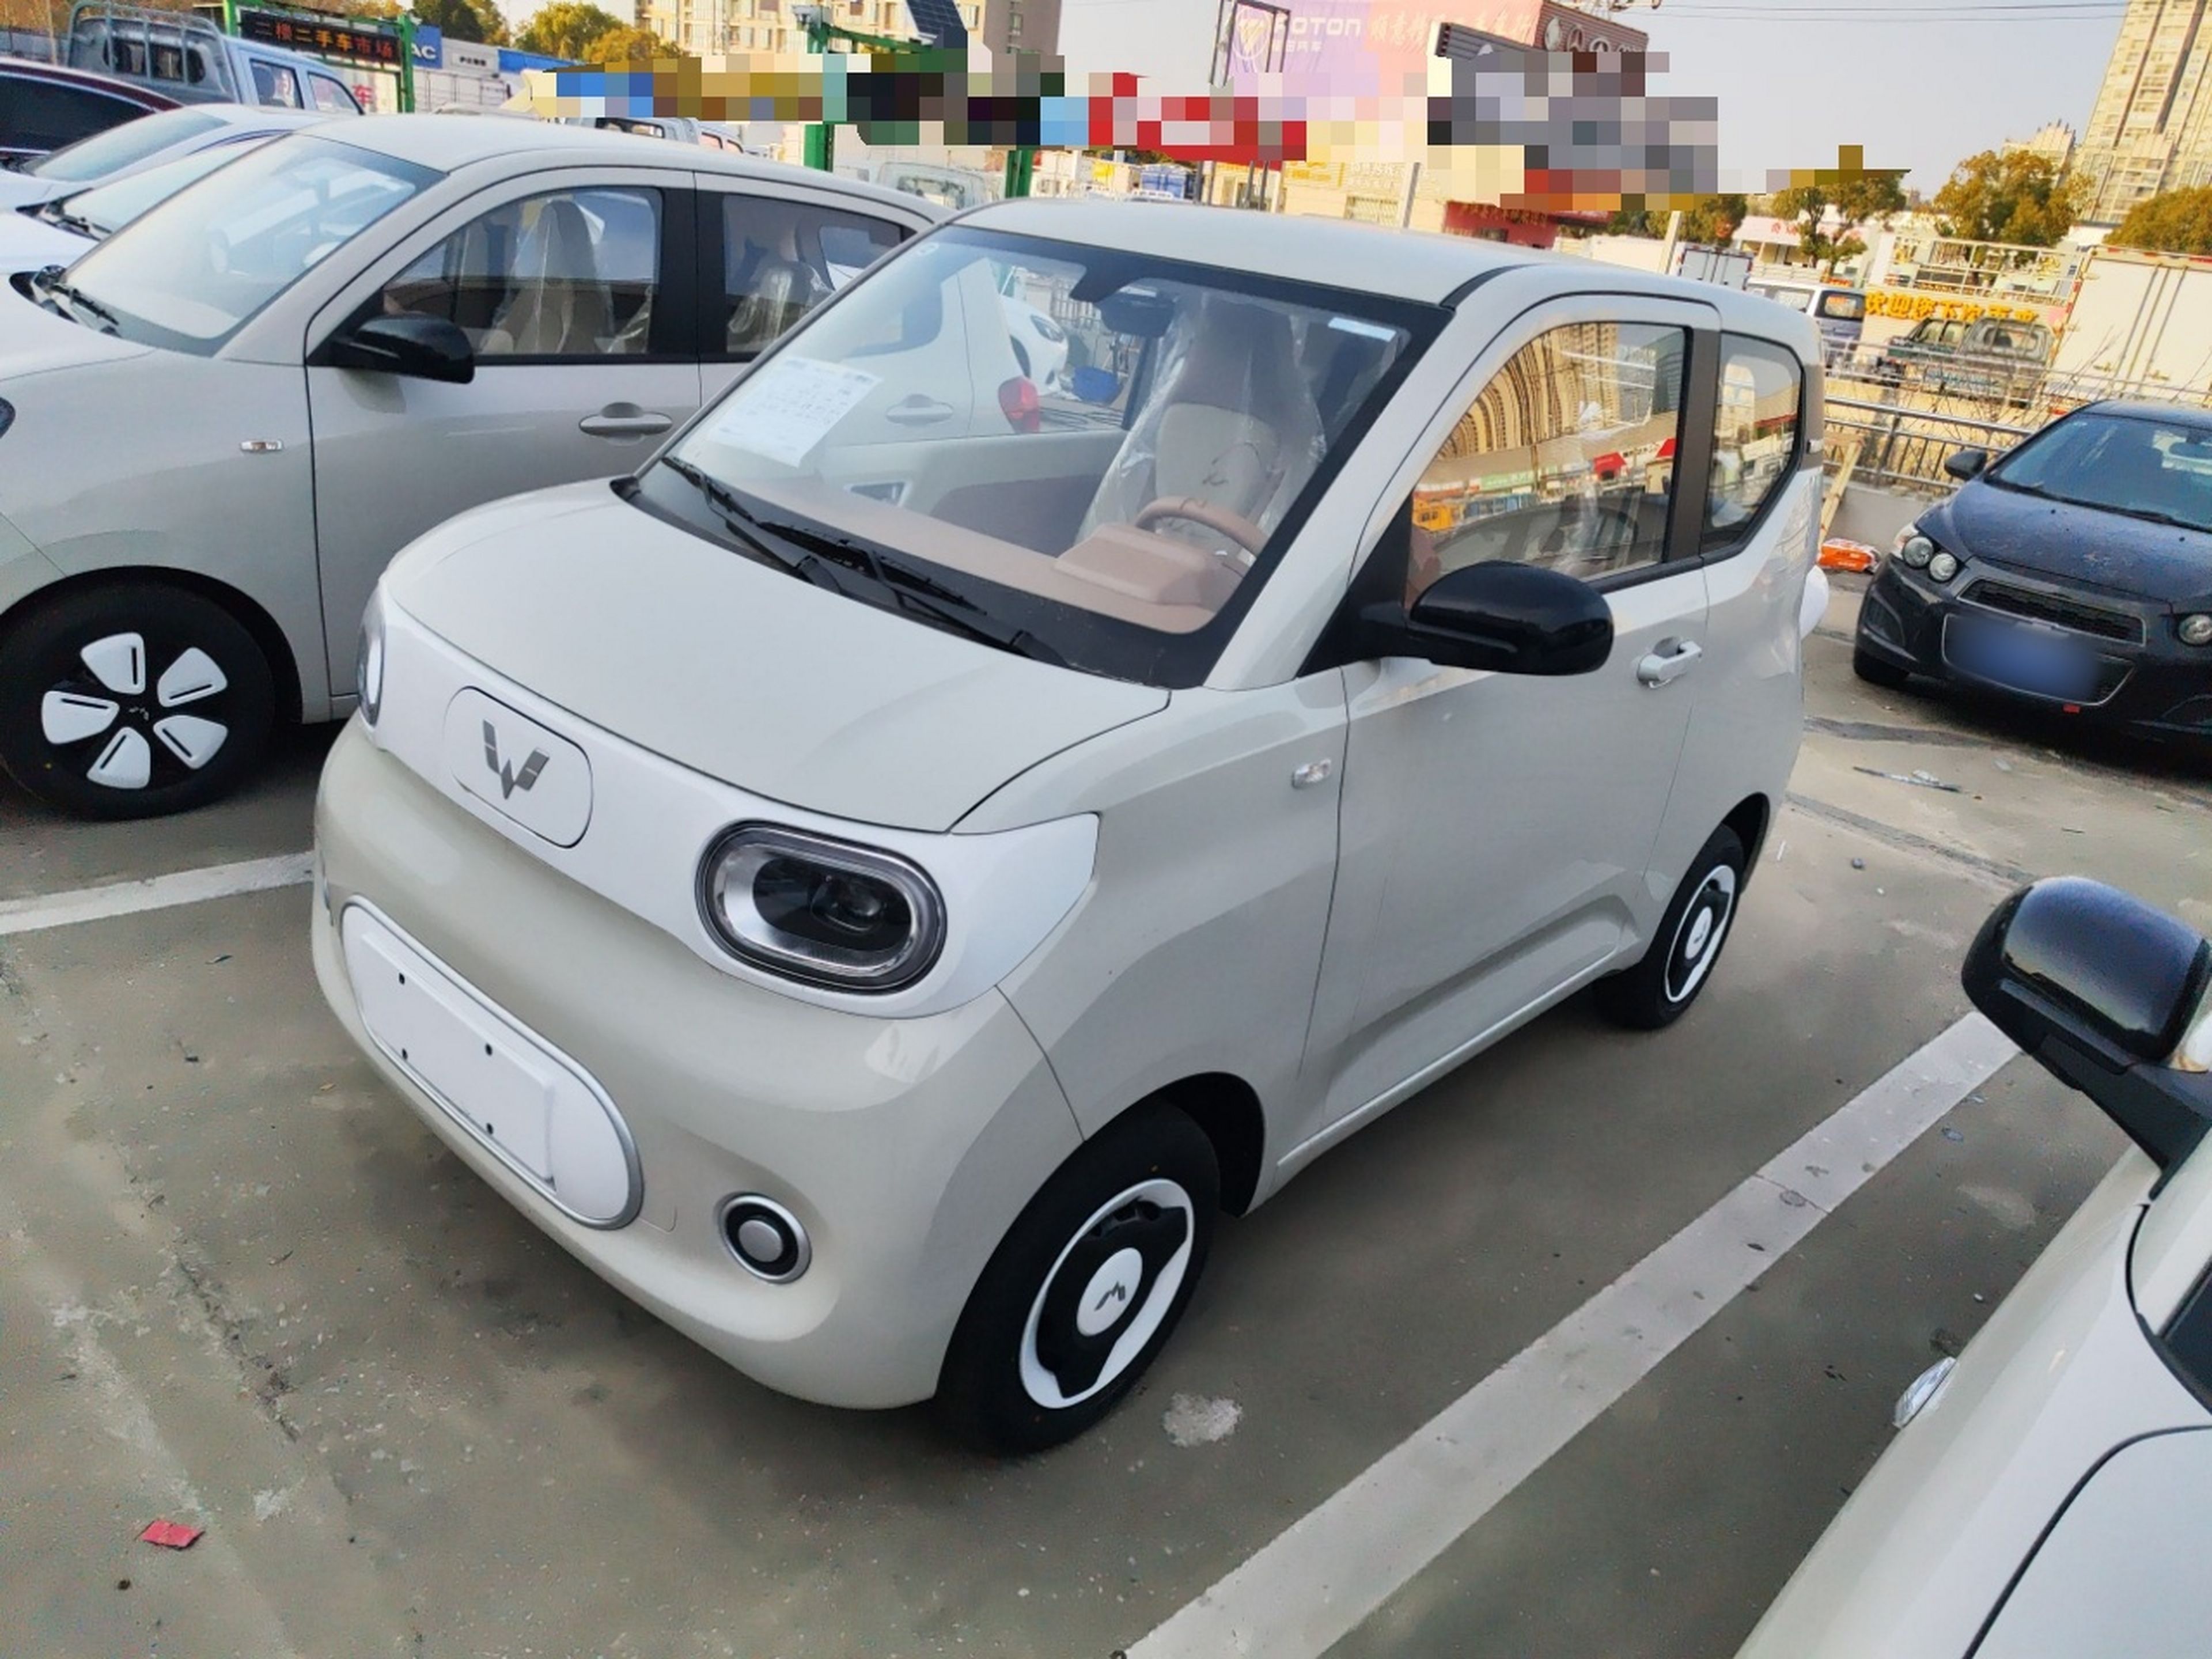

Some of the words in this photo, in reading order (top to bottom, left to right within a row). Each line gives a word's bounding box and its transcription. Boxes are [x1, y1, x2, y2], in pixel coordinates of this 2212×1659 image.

[255, 21, 393, 57] 二楼二手车市场
